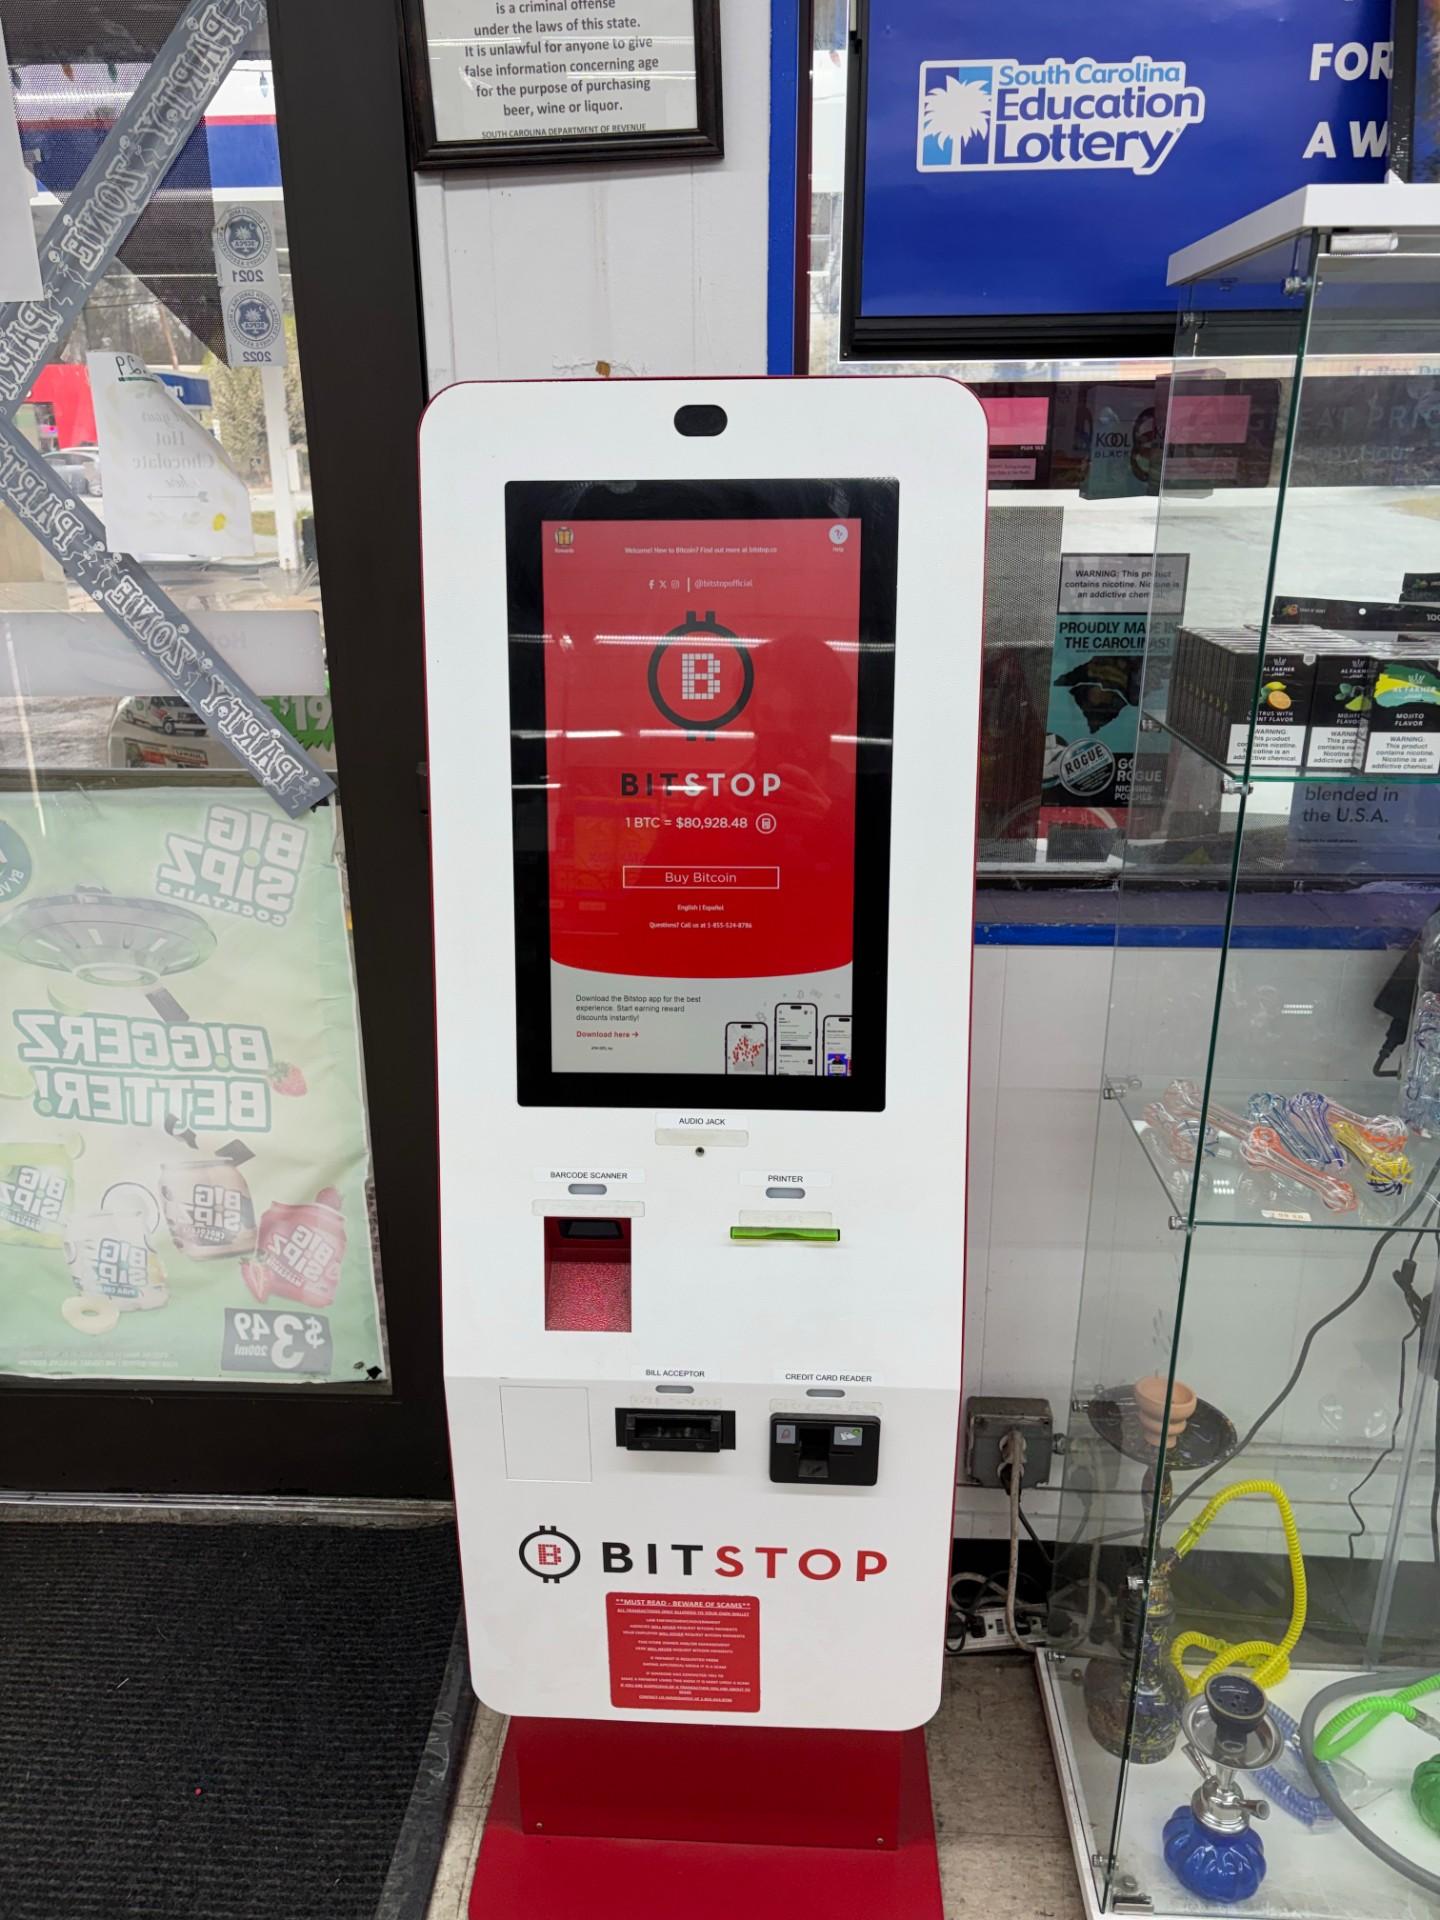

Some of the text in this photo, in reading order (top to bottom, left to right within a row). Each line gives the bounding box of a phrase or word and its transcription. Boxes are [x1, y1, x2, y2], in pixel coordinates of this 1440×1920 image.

[496, 0, 616, 14] is a criminal offense
[474, 16, 640, 36] under the laws of this state.
[465, 36, 653, 57] It is unlawful for anyone to give
[464, 58, 659, 78] false information concerning age
[1309, 42, 1394, 81] FOR
[999, 62, 1181, 86] South Carolina
[476, 78, 651, 98] for the purpose of purchasing
[504, 98, 623, 118] beer, wine or liquor.
[996, 87, 1200, 121] Education
[482, 123, 646, 139] SOUTH CAROLINA DEPARTMENT OF REVENUE
[994, 124, 1177, 166] Lottery
[1302, 121, 1391, 160] A W
[1096, 433, 1131, 447] KOOL
[676, 546, 699, 554] Bitcoin?
[1075, 570, 1139, 578] WARNING: This
[1090, 591, 1127, 599] addictive
[1059, 622, 1120, 634] PROUDLY
[1065, 637, 1089, 649] THE
[1064, 745, 1105, 775] ROGUE
[621, 773, 782, 797] BITSTOP
[1305, 786, 1399, 802] blended in
[1303, 808, 1389, 823] the U.S.A.
[626, 817, 630, 828] 1
[634, 817, 661, 828] BTC
[676, 816, 748, 830] $80,928.48
[665, 872, 737, 884] Buy Bitcoin
[678, 904, 699, 912] English
[650, 922, 680, 930] Questions?
[576, 994, 610, 1002] Download
[624, 995, 648, 1004] Bitstop
[648, 996, 662, 1004] app
[610, 1014, 640, 1023] instantly!
[705, 1118, 726, 1126] JACK
[590, 1172, 628, 1180] SCANNER
[768, 1174, 804, 1183] PRINTER
[646, 1369, 705, 1378] BILL ACCEPTOR
[785, 1373, 873, 1382] CREDIT CARD READER
[602, 1540, 888, 1582] BITSTOP
[672, 1600, 705, 1608] BEWARE
[706, 1601, 715, 1609] OF
